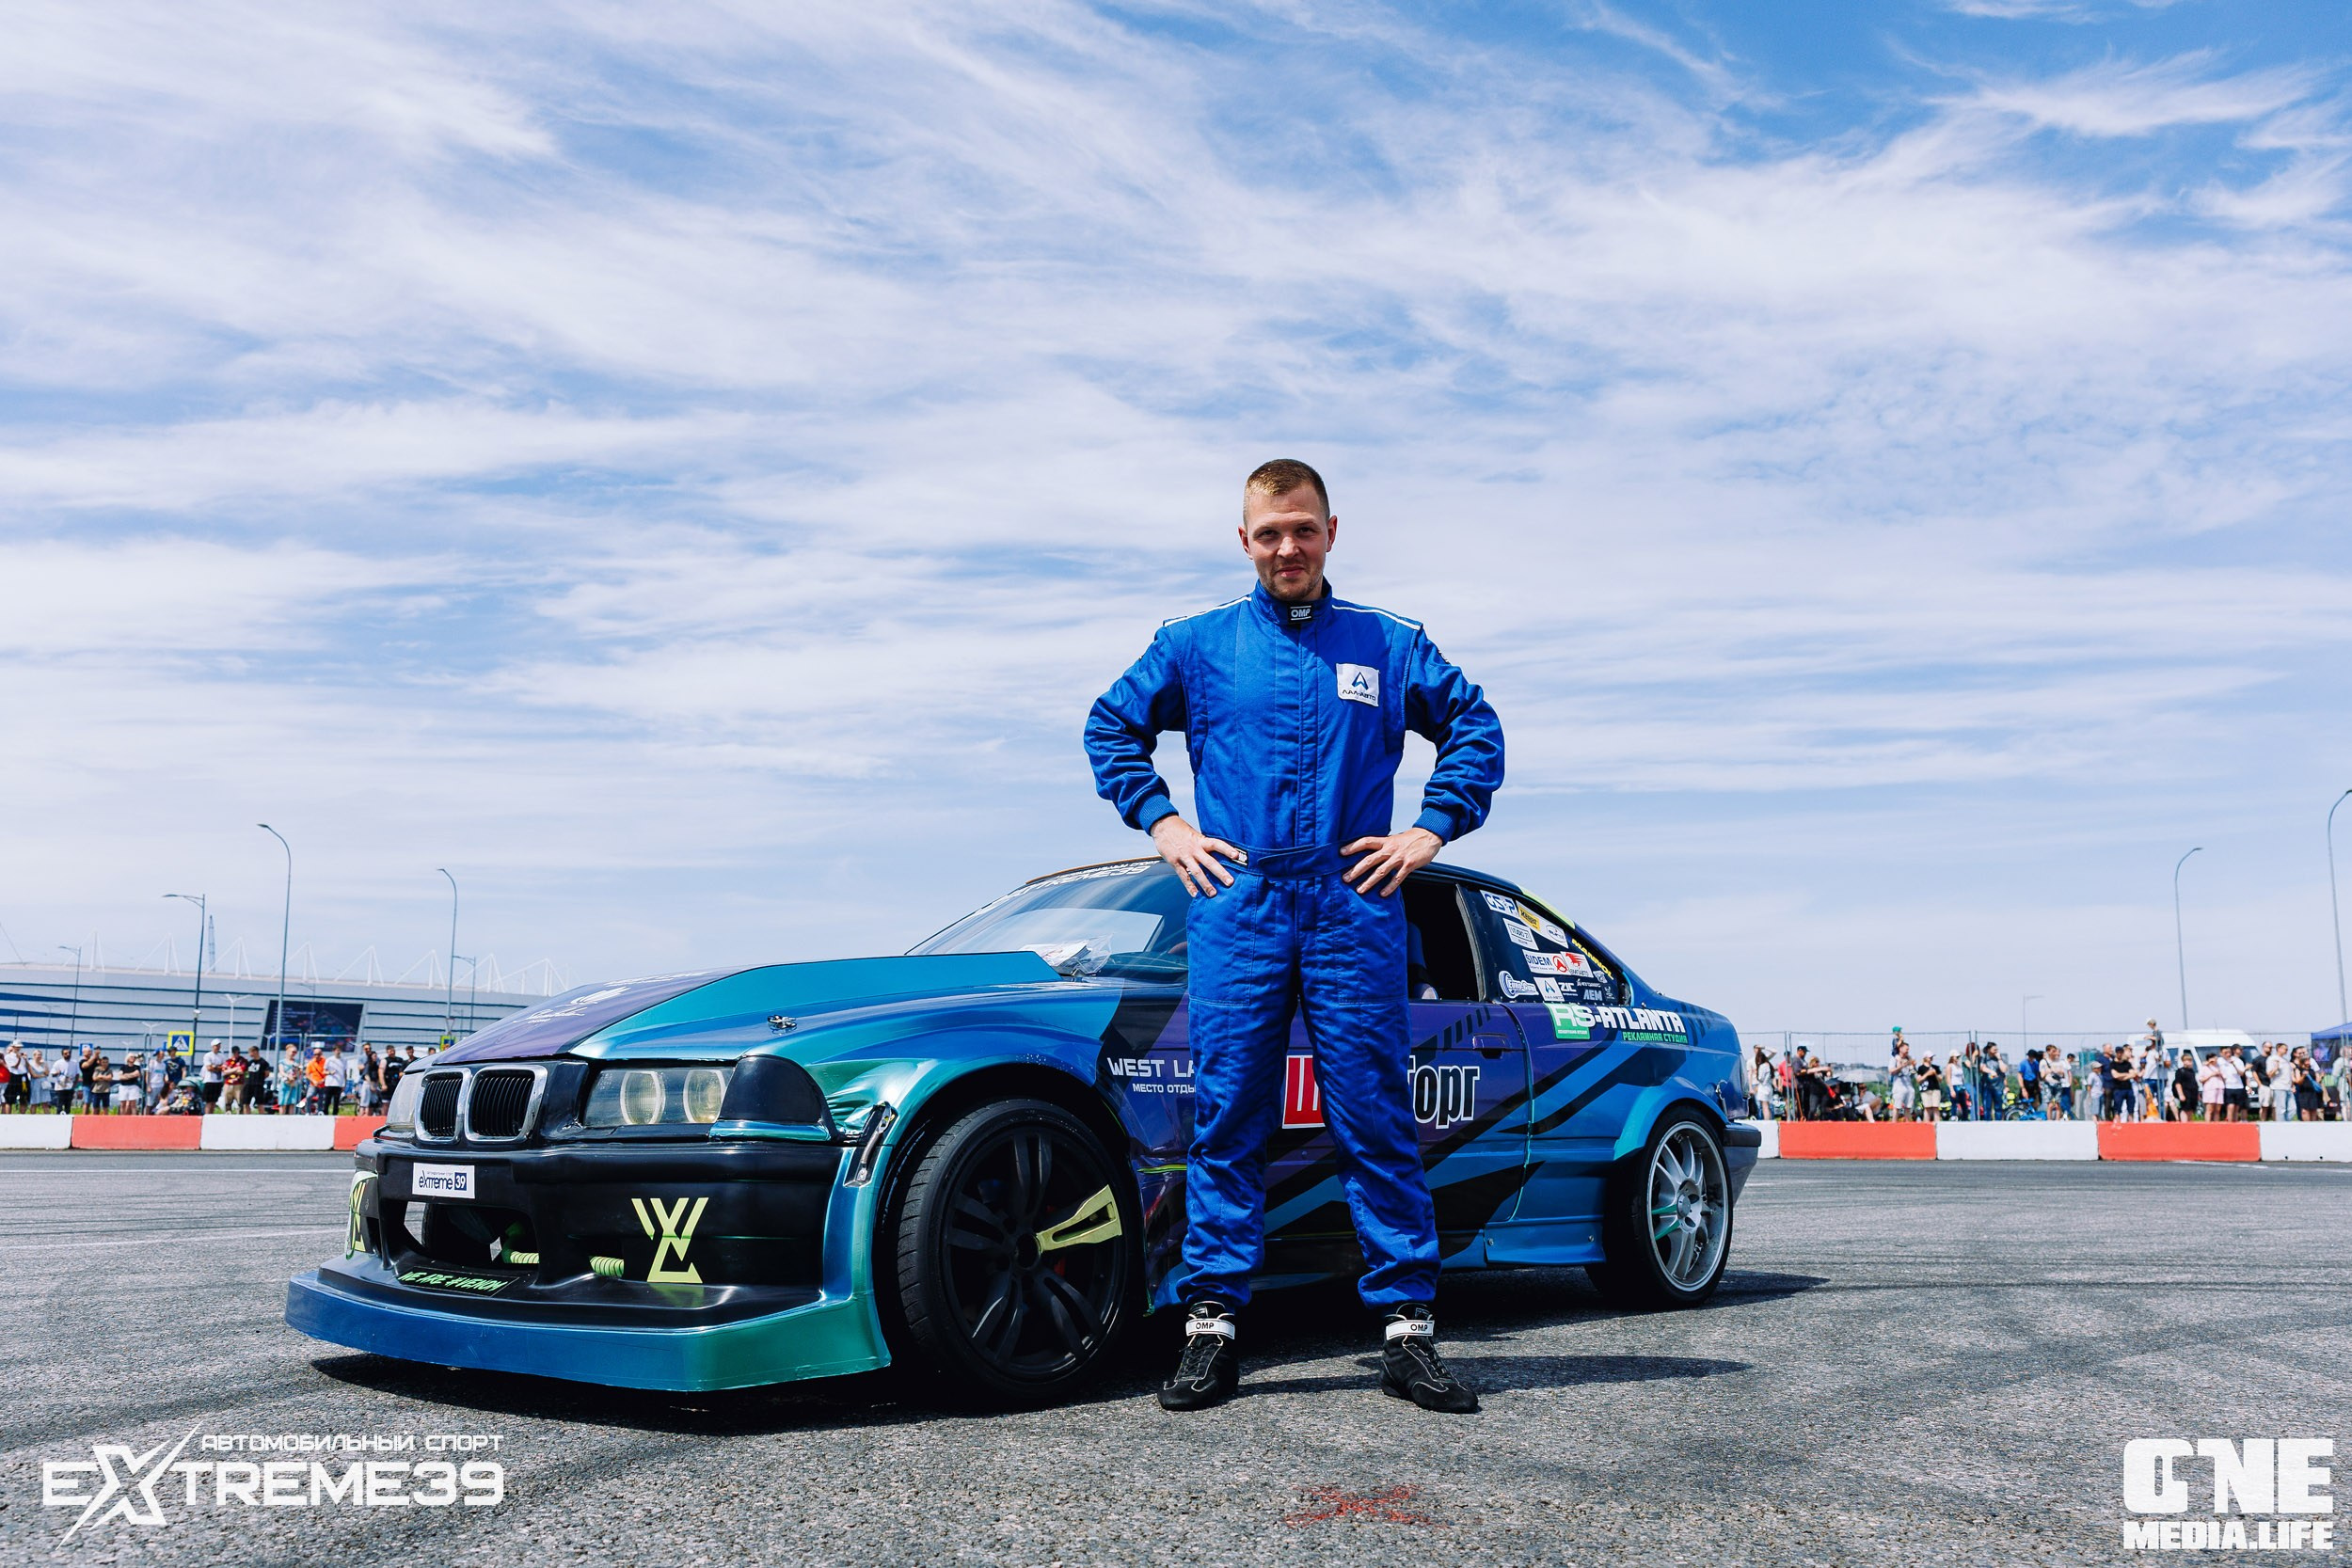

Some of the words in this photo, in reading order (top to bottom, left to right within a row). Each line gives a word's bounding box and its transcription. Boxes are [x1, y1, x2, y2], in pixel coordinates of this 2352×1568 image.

[1291, 609, 1311, 617] OMP
[1525, 954, 1552, 966] SIDEM
[1571, 939, 1613, 980] MANNOL
[1558, 982, 1577, 991] ZIC
[1549, 1006, 1686, 1033] RS-ATLANTA
[1623, 1031, 1663, 1041] РЕКЛАМНАЯ
[1663, 1033, 1688, 1043] СТУДИЯ
[1107, 1057, 1165, 1078] WEST
[1173, 1060, 1194, 1078] LA
[1133, 1084, 1164, 1093] МЕСТО
[1167, 1085, 1197, 1094] ОТДЫ
[455, 1174, 467, 1189] 39
[398, 1272, 427, 1281] WE
